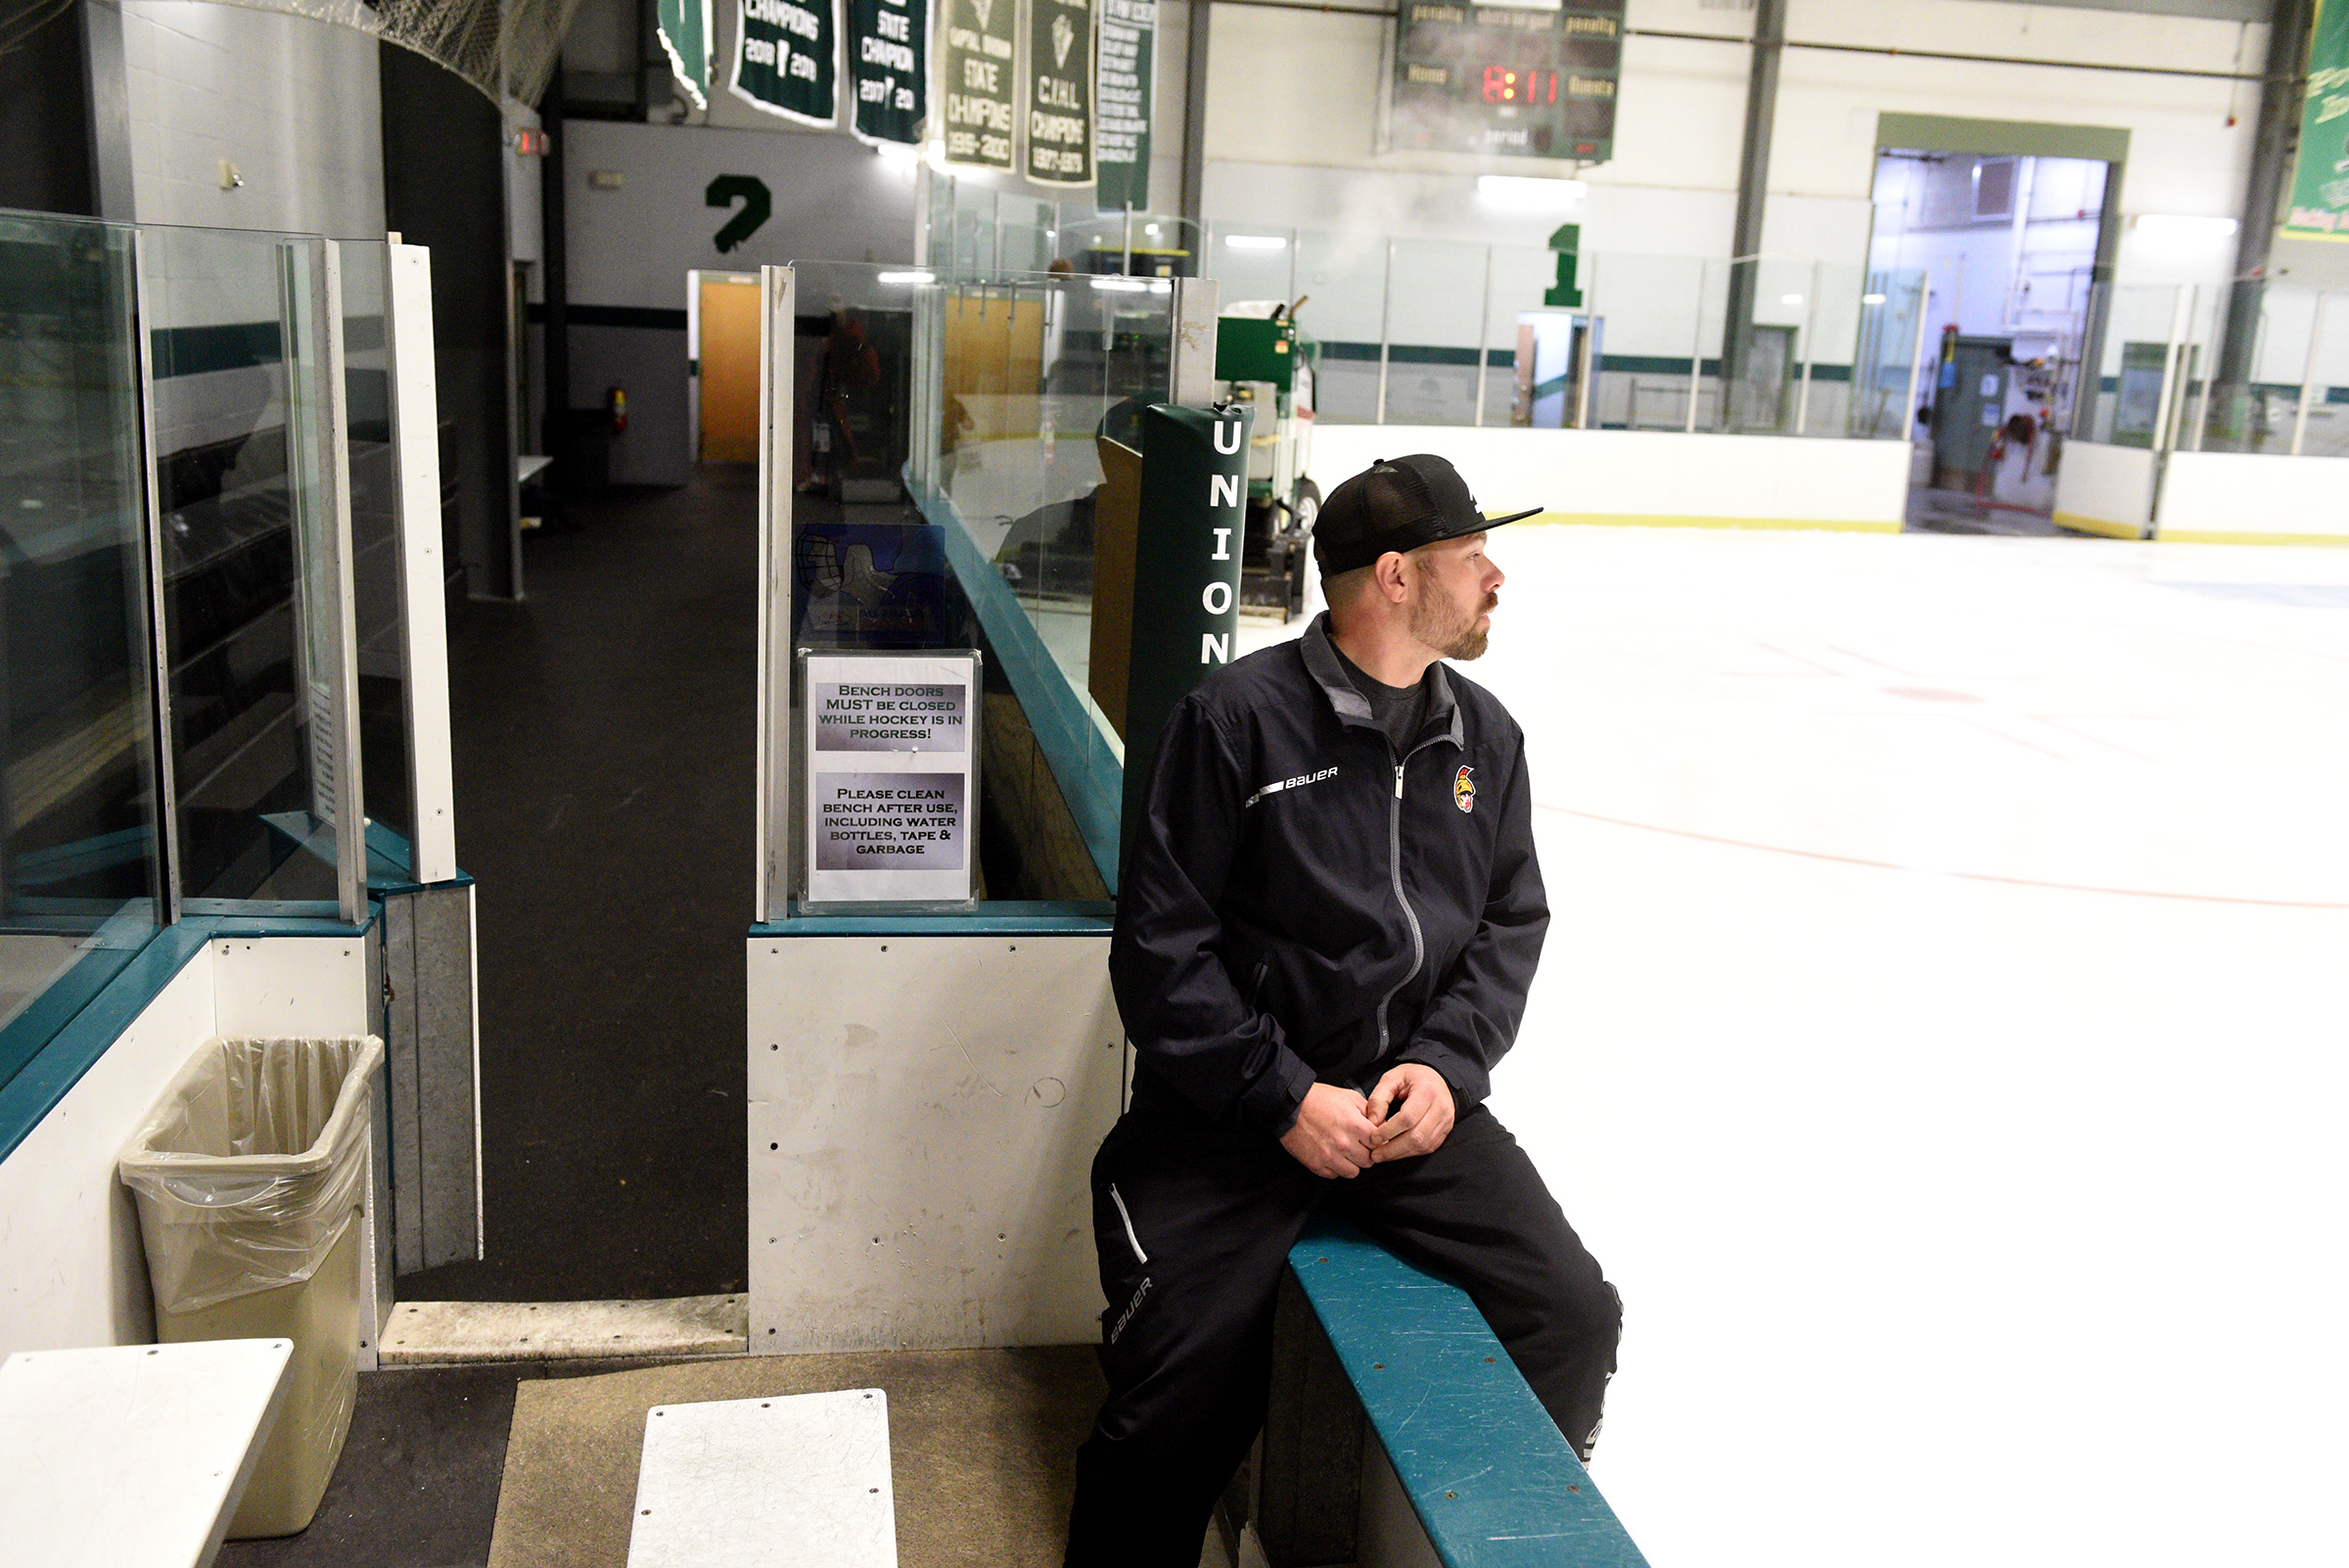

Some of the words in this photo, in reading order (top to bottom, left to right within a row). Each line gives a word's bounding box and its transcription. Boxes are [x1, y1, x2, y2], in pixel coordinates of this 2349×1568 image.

[877, 9, 911, 44] STATE
[963, 58, 999, 94] STATE
[1543, 223, 1583, 307] 1
[1201, 420, 1242, 665] UNION
[839, 685, 891, 697] BENCH
[895, 687, 944, 697] DOORS
[826, 699, 873, 711] MUST
[876, 701, 896, 711] BE
[898, 701, 956, 712] CLOSED
[818, 715, 865, 724] WHILE
[869, 715, 928, 725] HOCKEY
[931, 715, 944, 725] IS
[947, 715, 962, 725] IN
[850, 728, 932, 739] PROGRESS!
[1285, 766, 1338, 790] BAUER
[837, 788, 894, 800] PLEASE
[897, 790, 944, 800] CLEAN
[823, 804, 873, 813] BENCH
[876, 804, 923, 813] AFTER
[926, 804, 958, 814] USE,
[824, 817, 902, 827] INCLUDING
[906, 817, 956, 827] WATER
[830, 831, 897, 842] BOTTLES,
[900, 831, 936, 841] TAPE
[940, 829, 951, 841] &
[856, 845, 925, 854] GARBAGE
